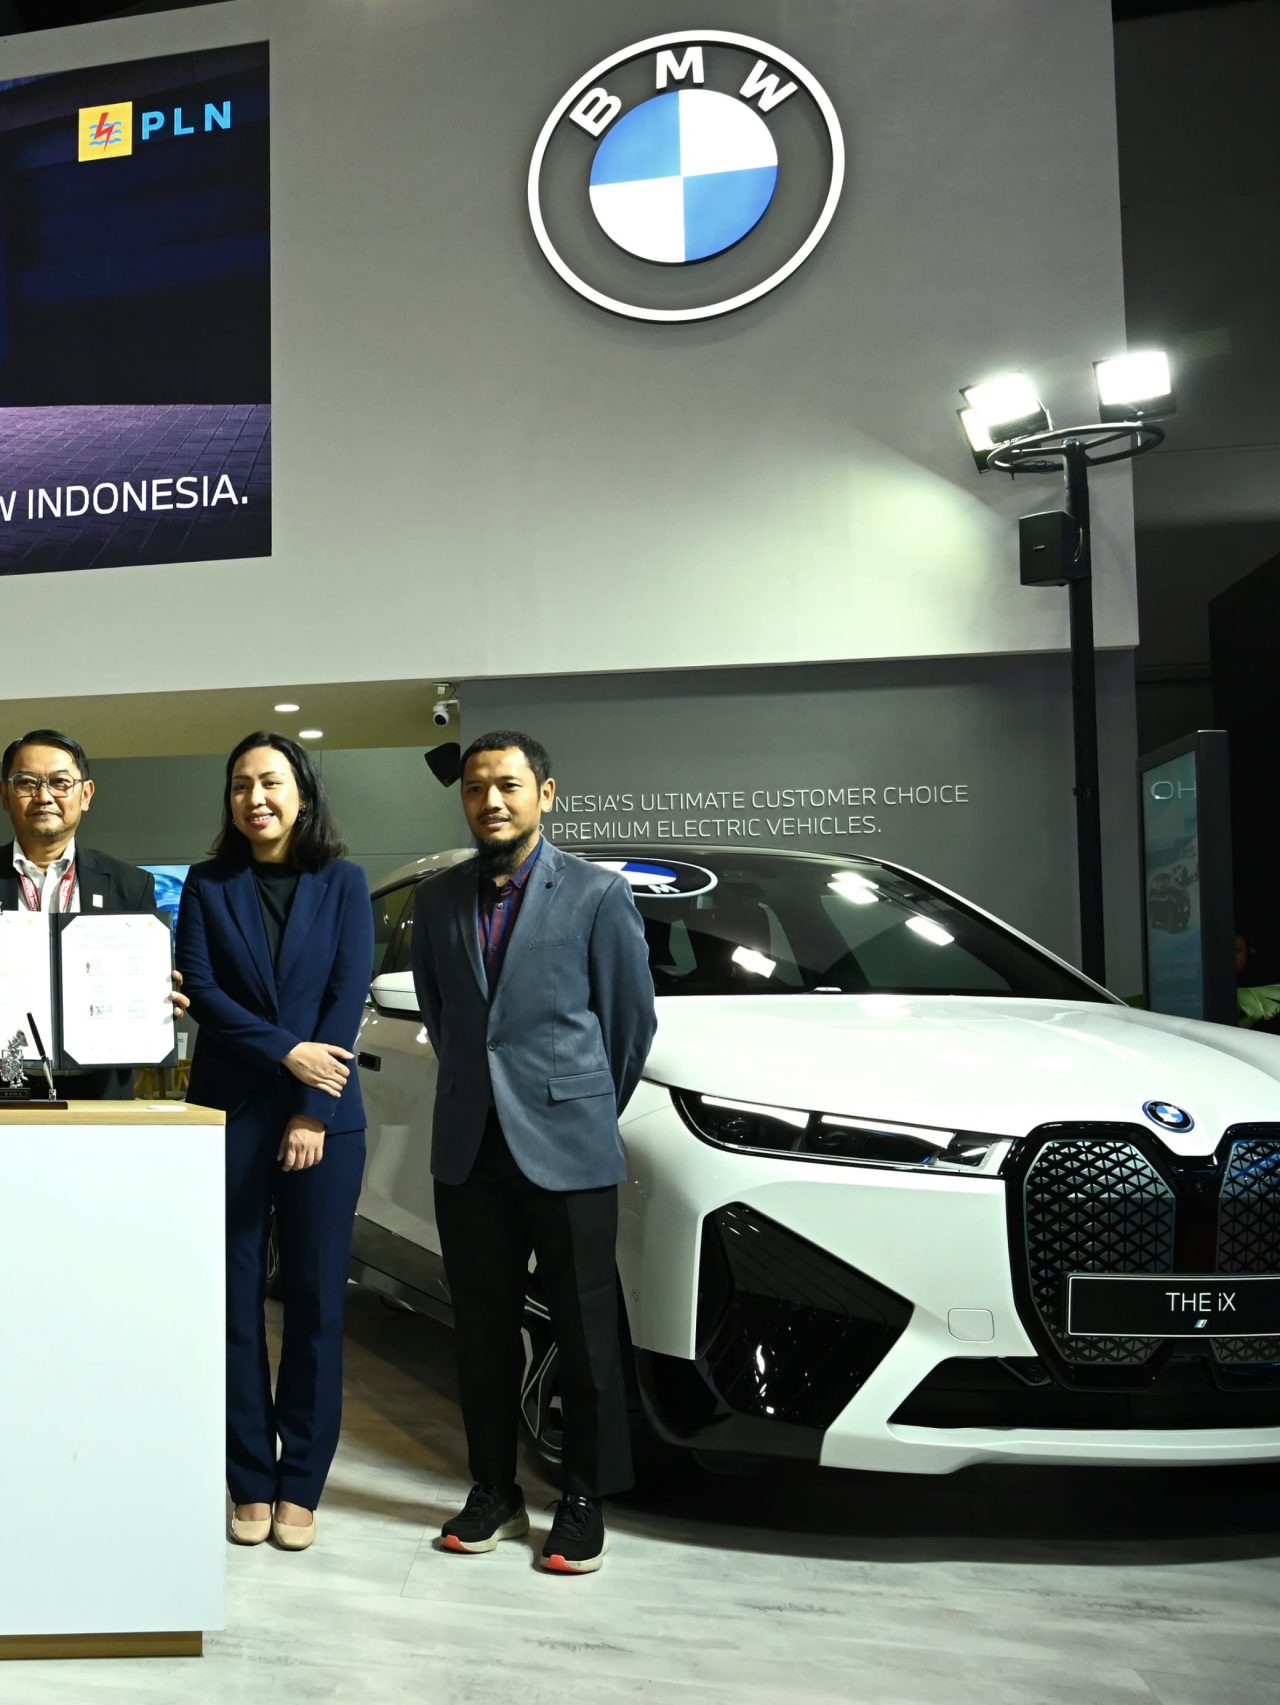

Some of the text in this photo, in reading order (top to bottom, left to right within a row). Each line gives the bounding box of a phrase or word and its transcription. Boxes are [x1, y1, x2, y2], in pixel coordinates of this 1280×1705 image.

[569, 46, 798, 138] BMW
[142, 101, 231, 140] PLN
[28, 474, 248, 520] INDONESIA.
[554, 784, 970, 813] NESIA'S ULTIMATE CUSTOMER CHOICE
[551, 820, 650, 840] PREMIUM
[657, 818, 761, 838] ELECTRIC
[765, 815, 882, 836] VEHICLES.
[1165, 1292, 1236, 1312] THE iX
